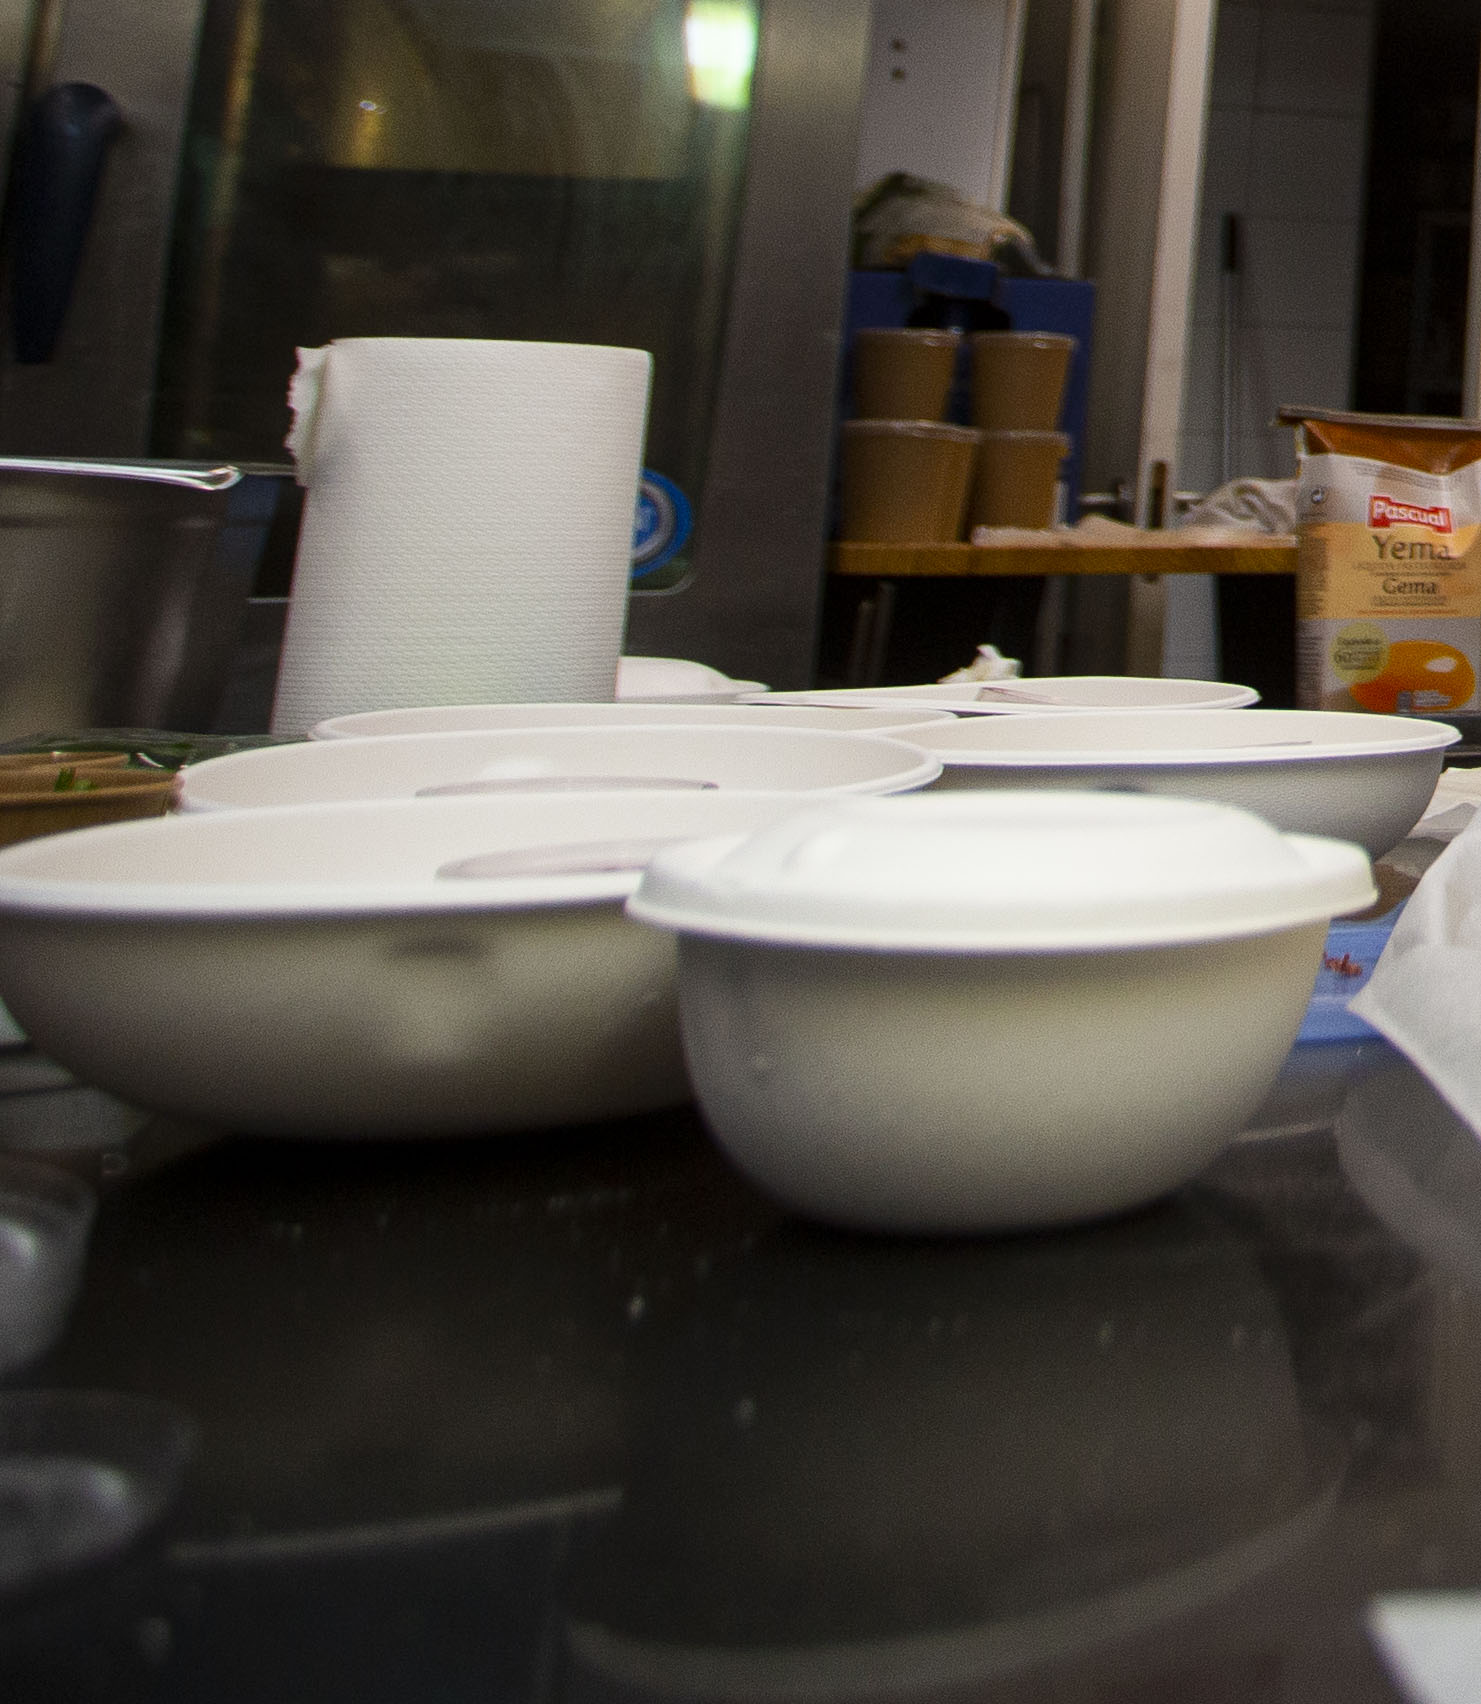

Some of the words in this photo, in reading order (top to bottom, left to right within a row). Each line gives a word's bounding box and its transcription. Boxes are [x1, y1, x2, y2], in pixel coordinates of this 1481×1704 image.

[1373, 500, 1447, 529] Pascual
[1371, 534, 1451, 561] Yema
[1381, 576, 1439, 595] Gema
